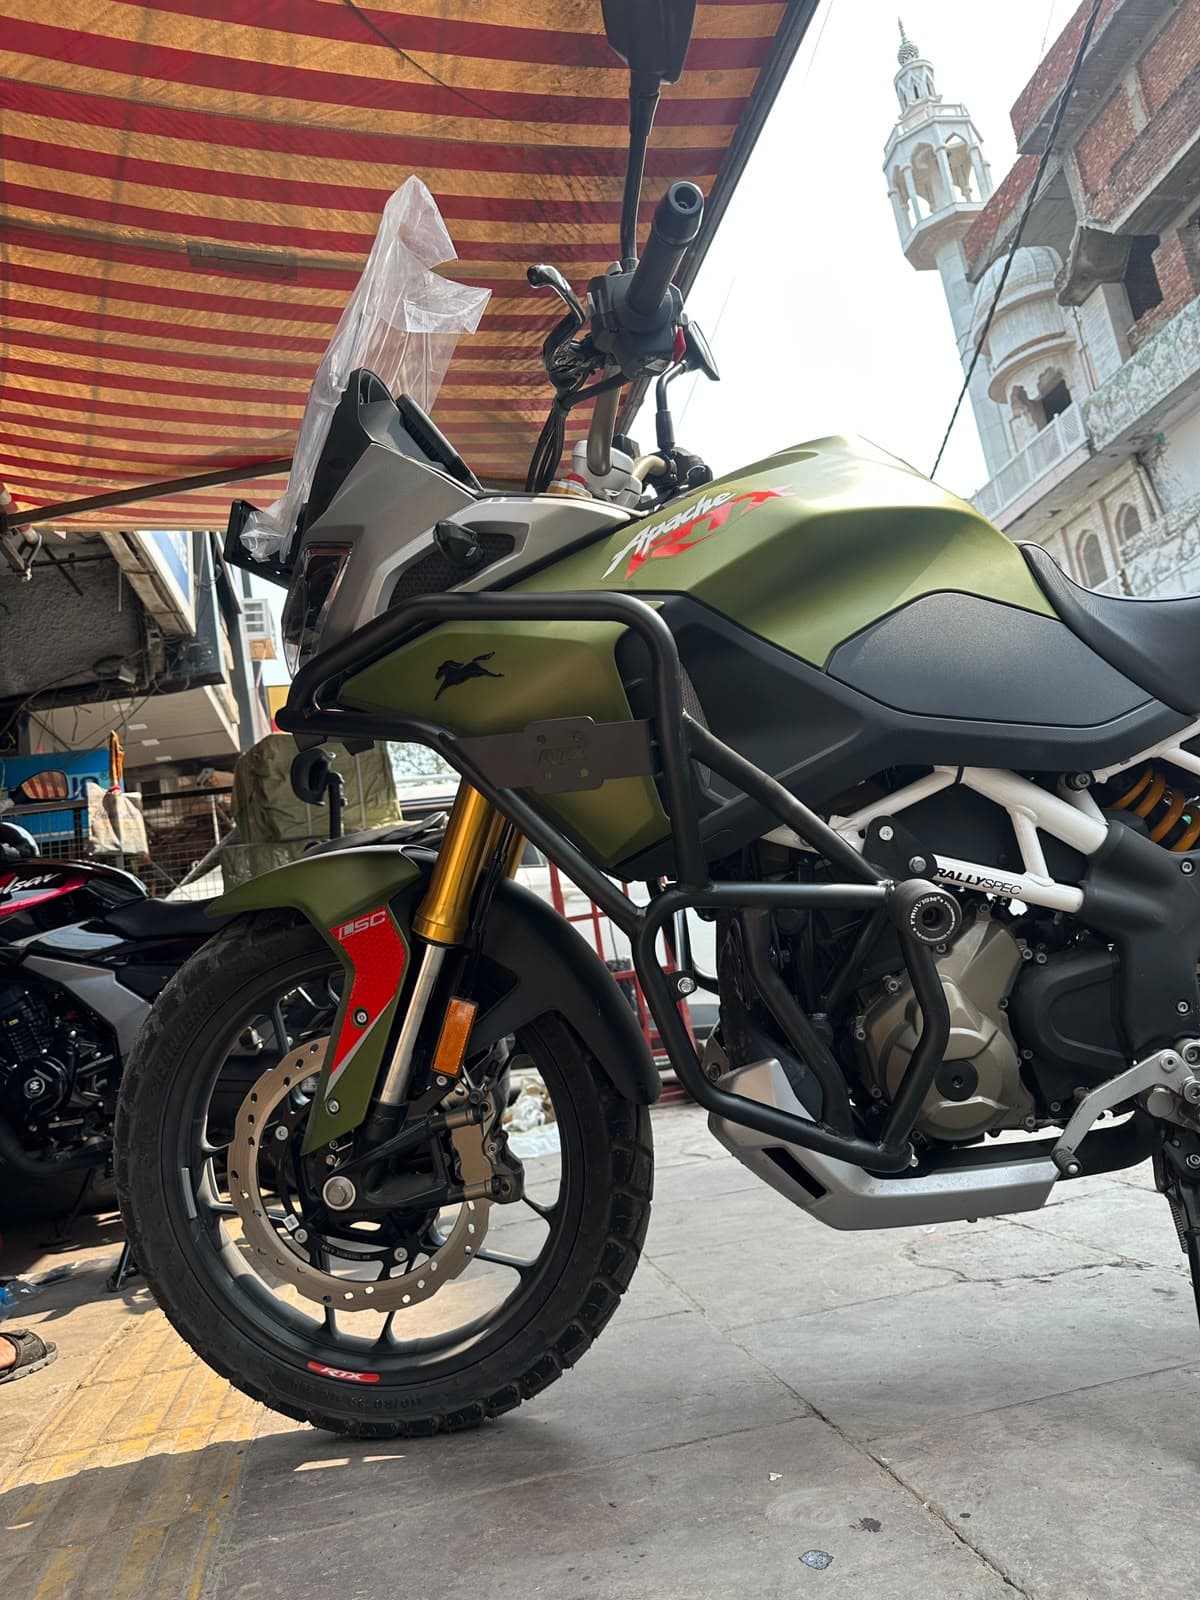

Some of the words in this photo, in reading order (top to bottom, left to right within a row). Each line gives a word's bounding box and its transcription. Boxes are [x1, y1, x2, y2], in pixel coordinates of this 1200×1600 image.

[600, 491, 736, 580] Apache
[0, 873, 62, 895] lsar
[936, 867, 1022, 896] RALLYSPEC
[320, 1366, 363, 1381] RTX
